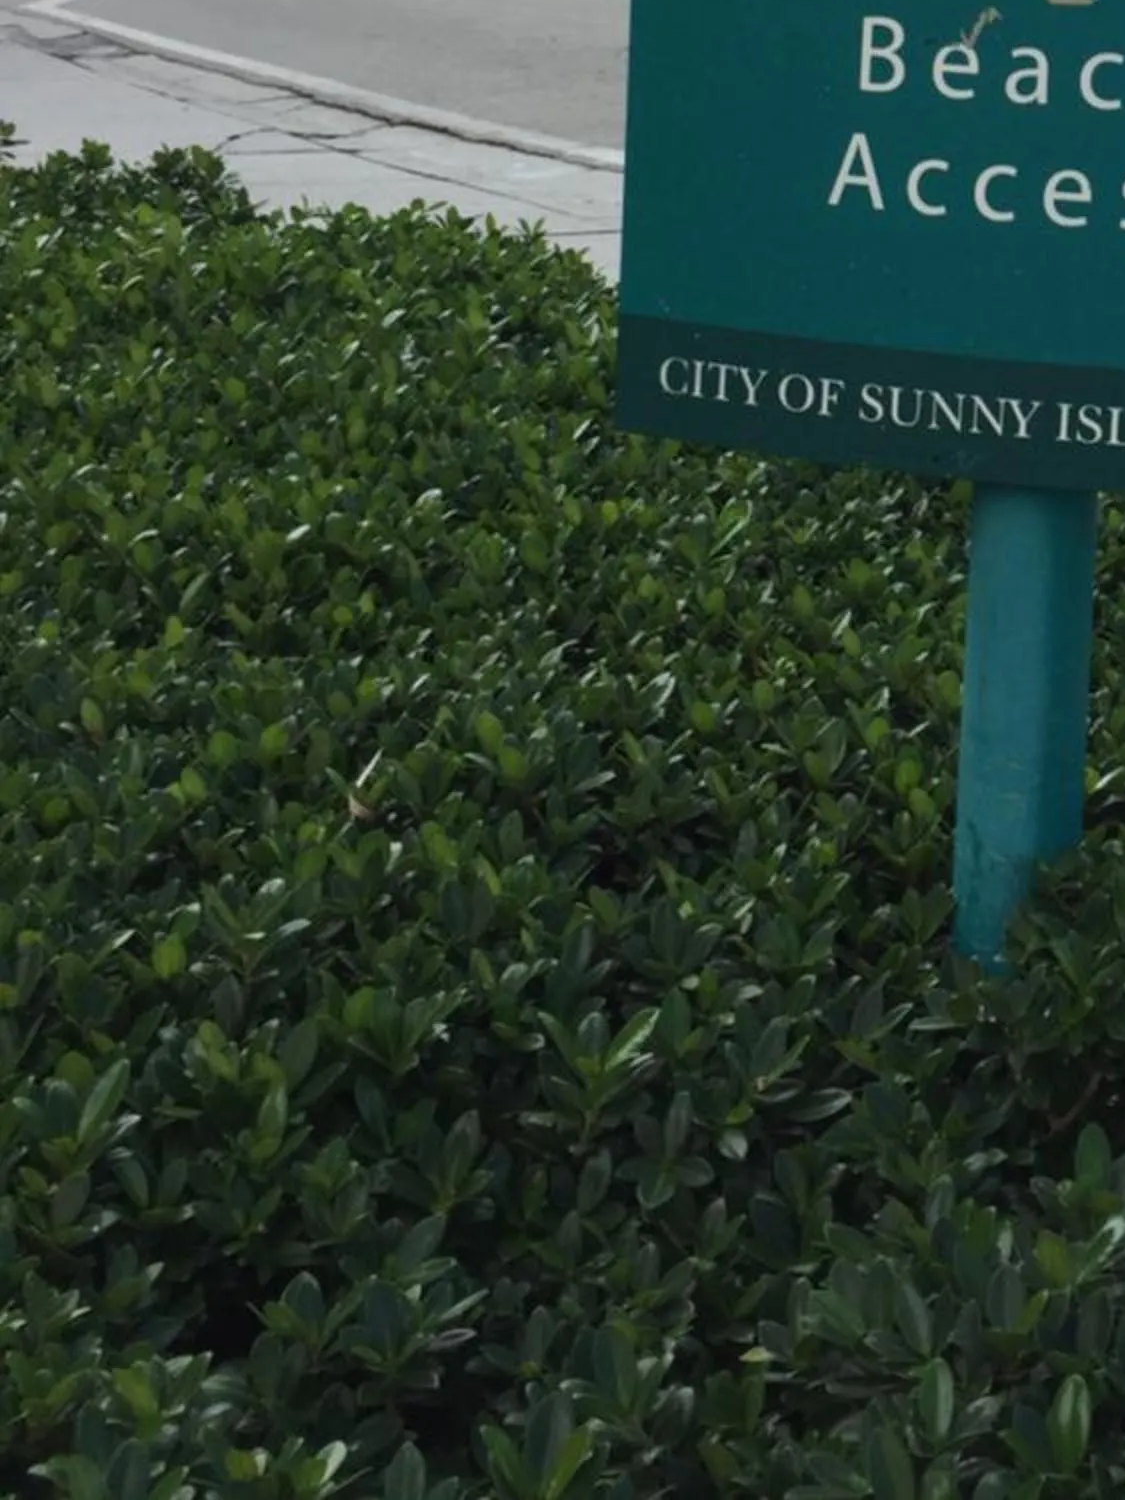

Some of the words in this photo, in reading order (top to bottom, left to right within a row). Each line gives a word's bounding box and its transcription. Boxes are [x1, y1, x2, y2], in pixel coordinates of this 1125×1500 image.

[658, 355, 768, 407] CITY
[777, 373, 846, 418] OF
[858, 383, 1041, 440] SUNNY
